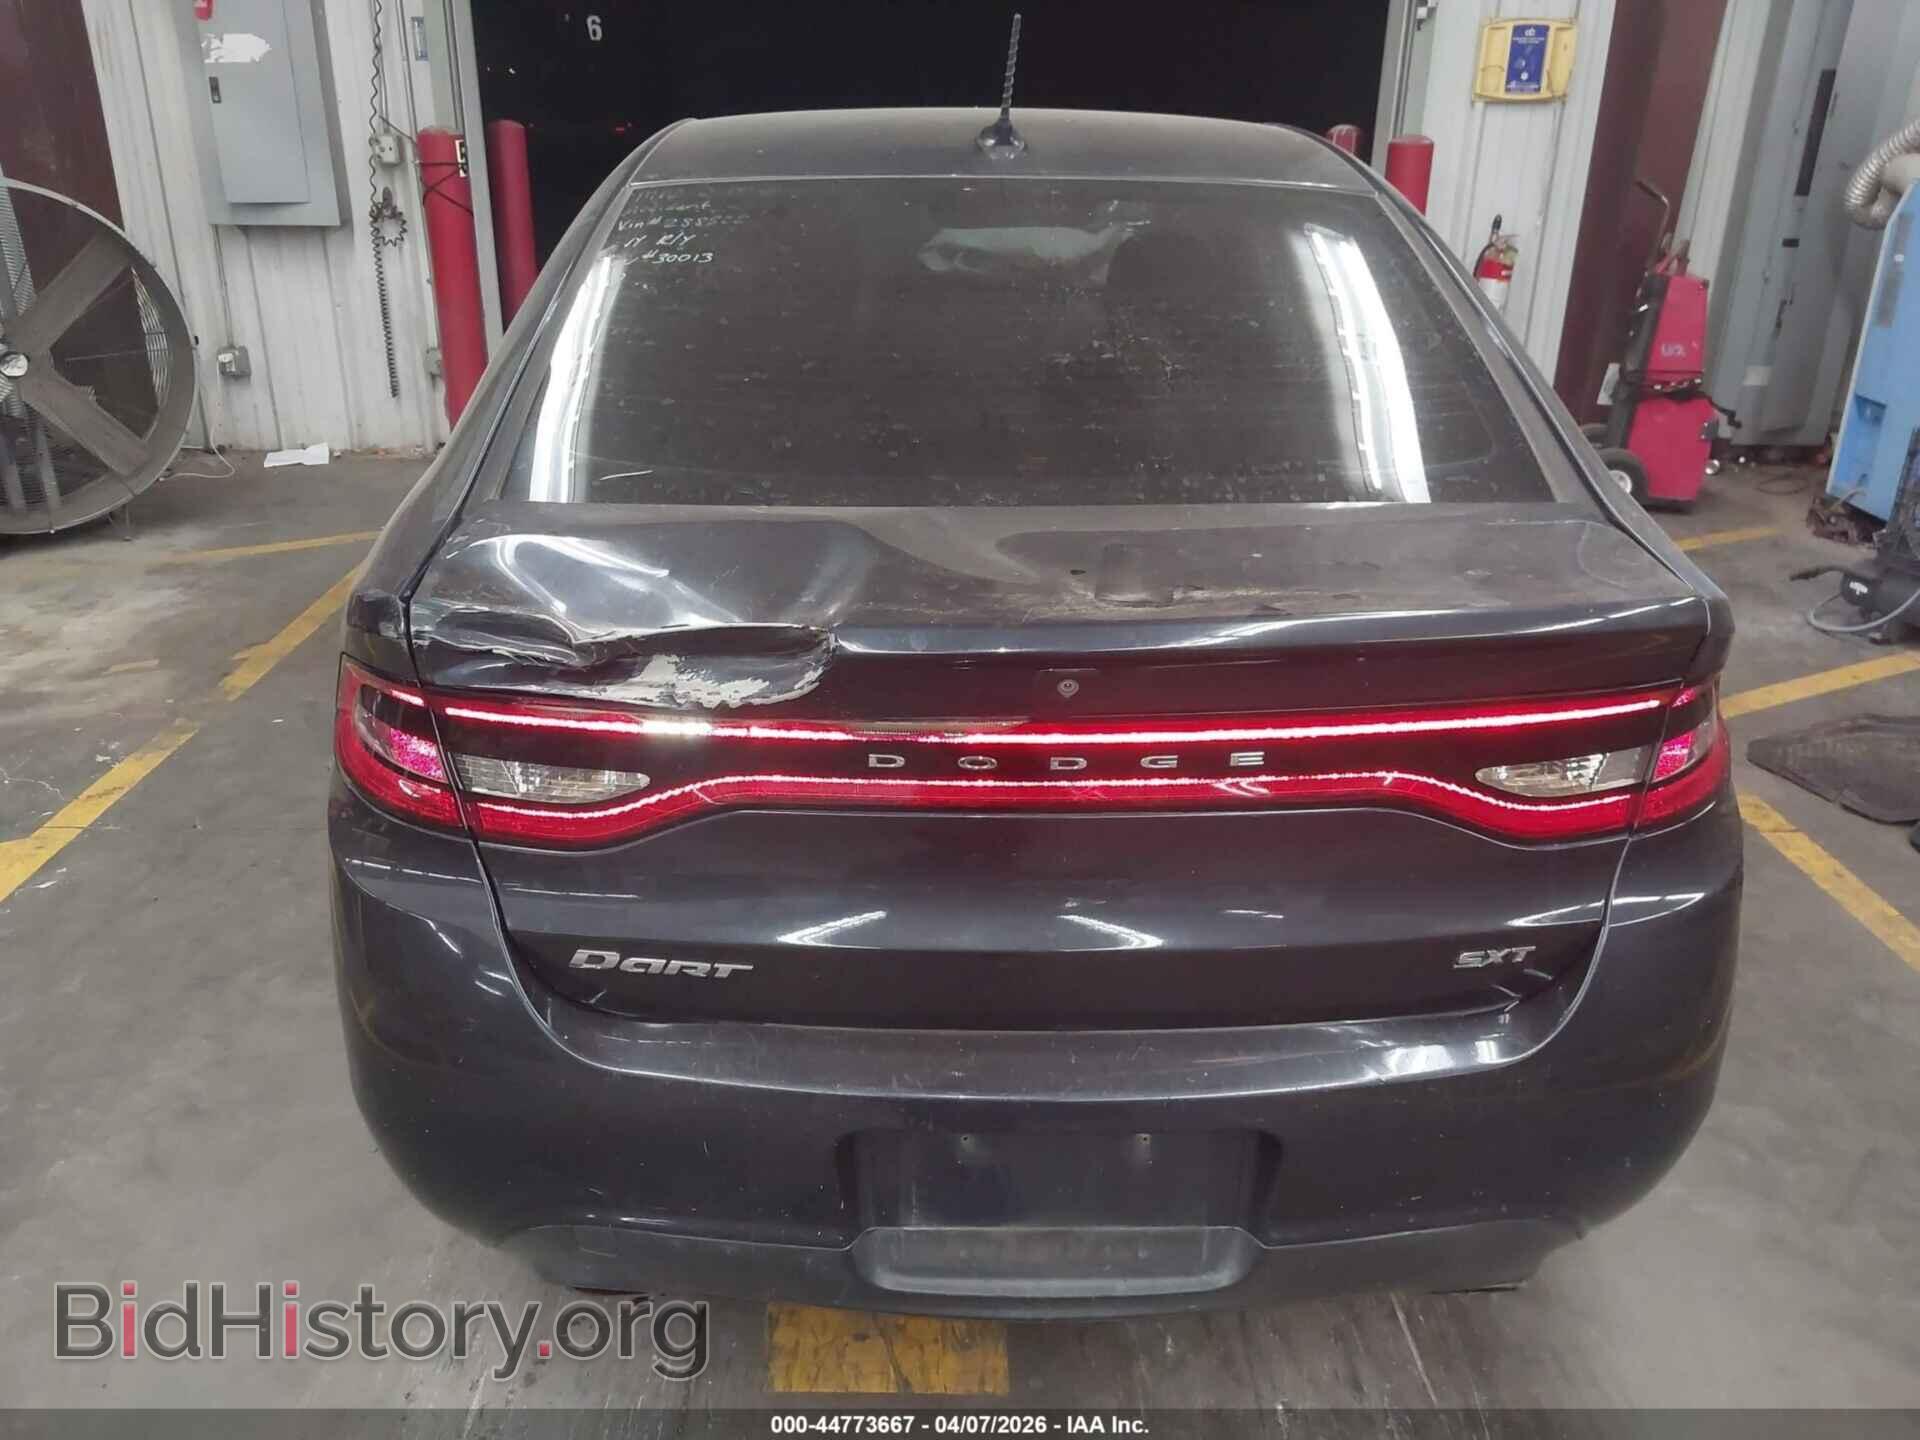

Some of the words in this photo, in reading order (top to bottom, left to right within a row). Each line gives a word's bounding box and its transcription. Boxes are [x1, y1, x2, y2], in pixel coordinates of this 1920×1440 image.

[586, 15, 602, 41] 6
[868, 752, 1266, 771] DODGE
[1453, 945, 1537, 969] SXT
